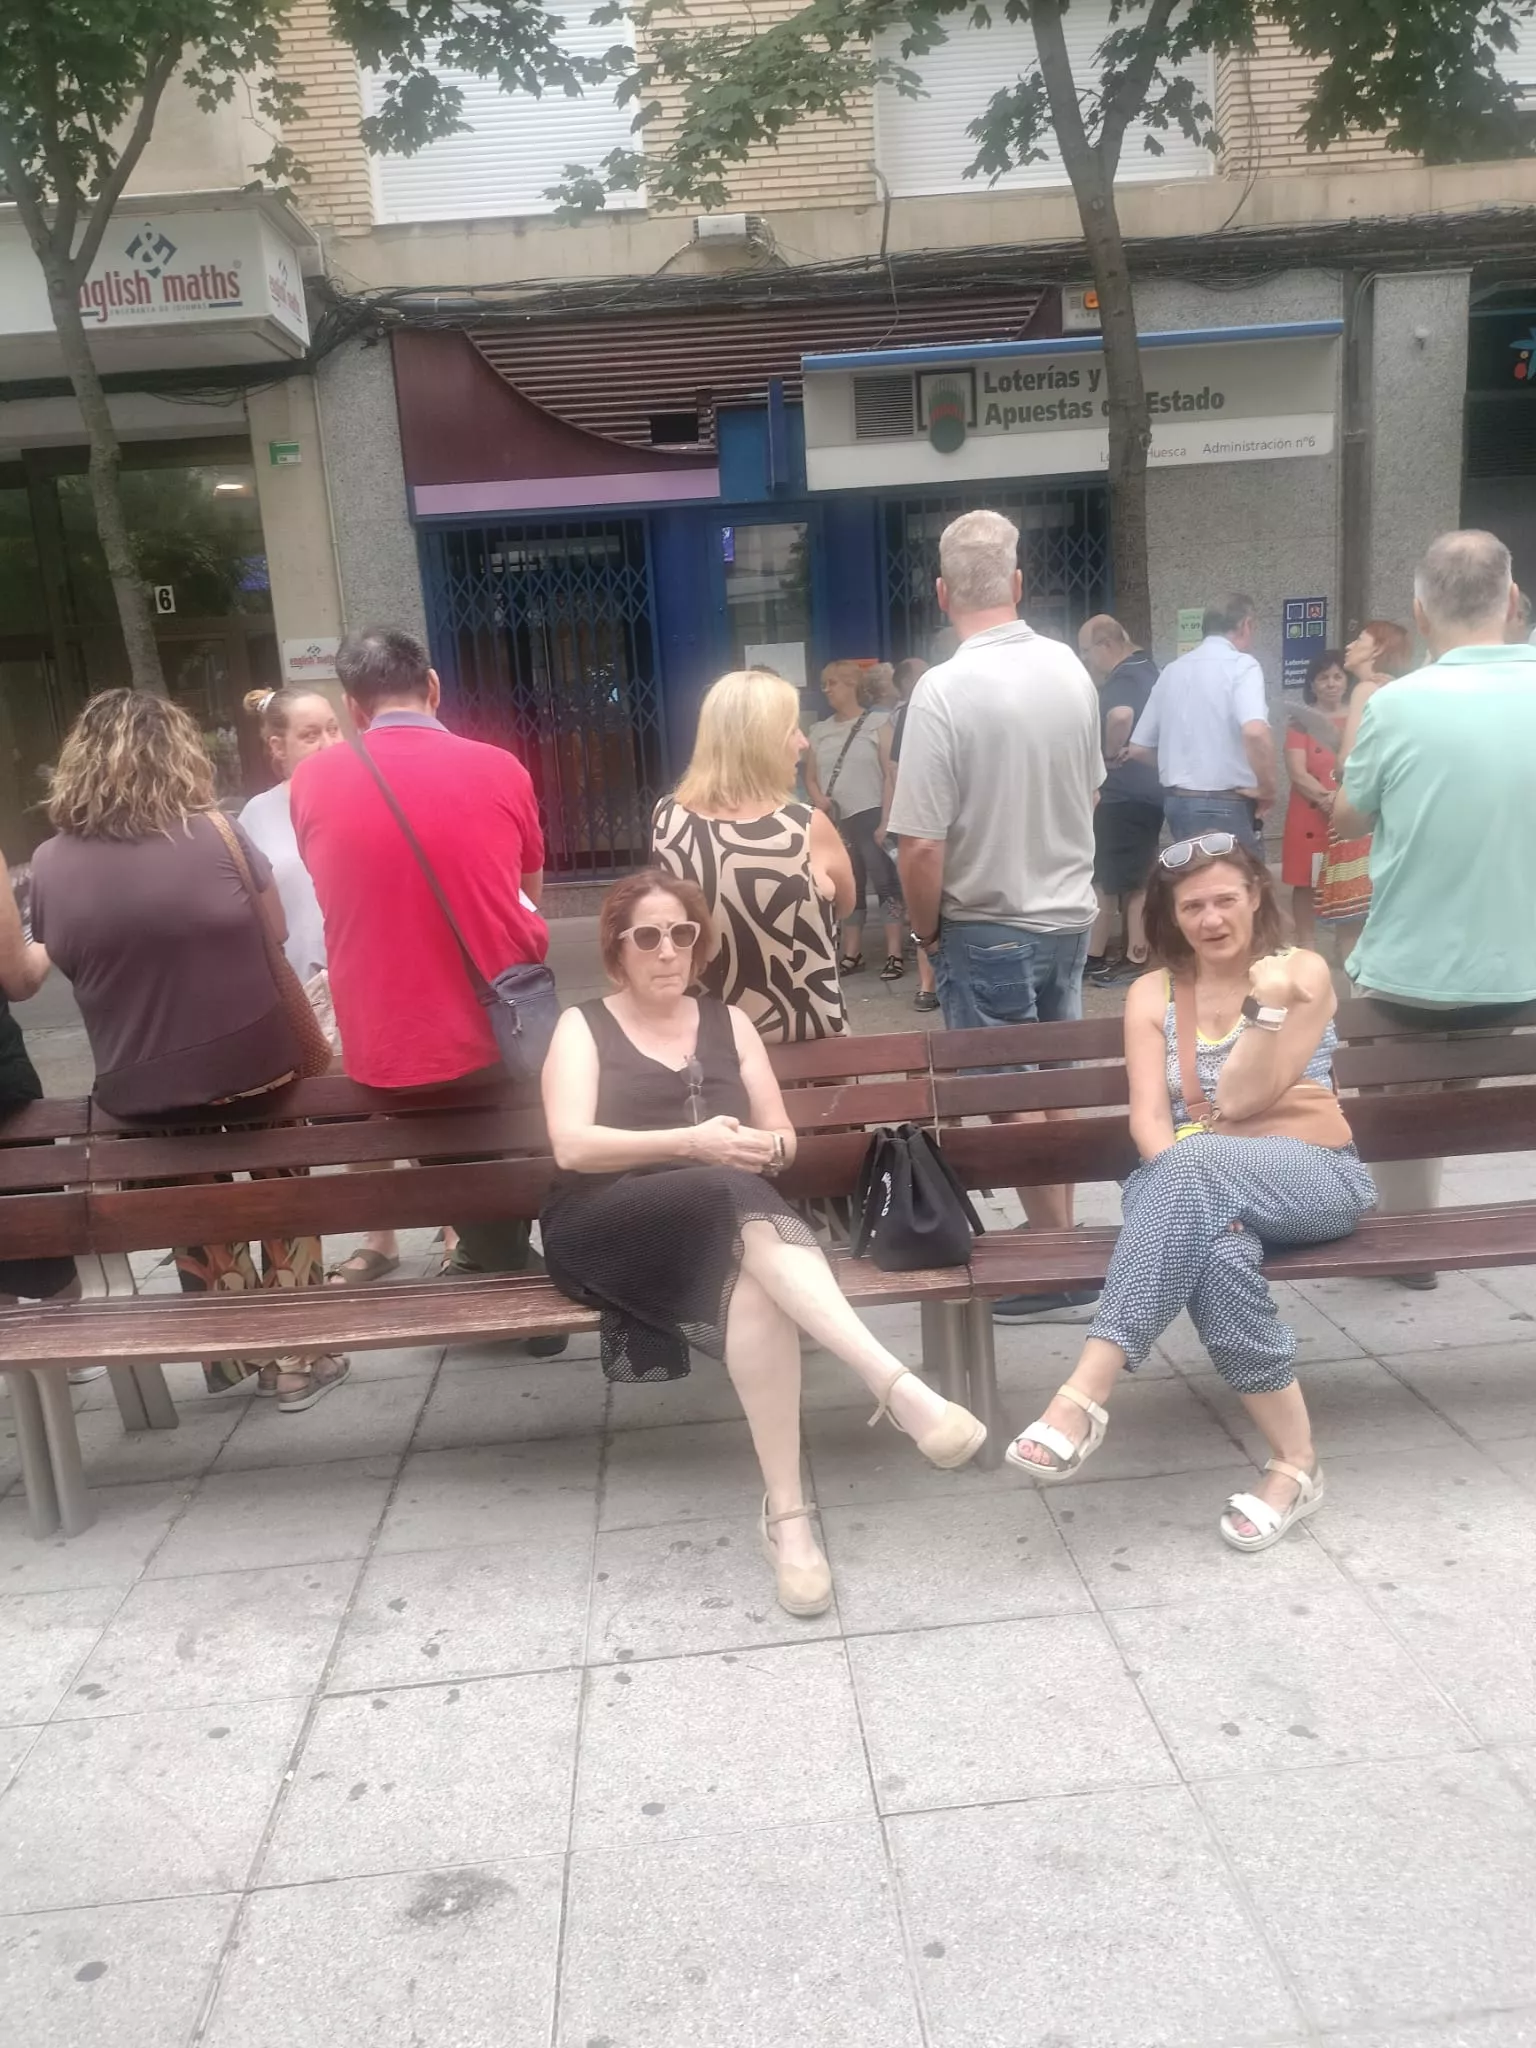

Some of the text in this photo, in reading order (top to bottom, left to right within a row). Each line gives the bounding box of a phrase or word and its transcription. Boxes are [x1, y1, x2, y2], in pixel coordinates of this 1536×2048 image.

[78, 264, 241, 323] nglish maths
[983, 365, 1102, 394] Loterías y
[984, 398, 1094, 431] Apuestas
[1145, 386, 1225, 414] Estado
[1147, 446, 1187, 459] Huesca
[1202, 436, 1293, 455] Administración
[158, 588, 172, 611] 6
